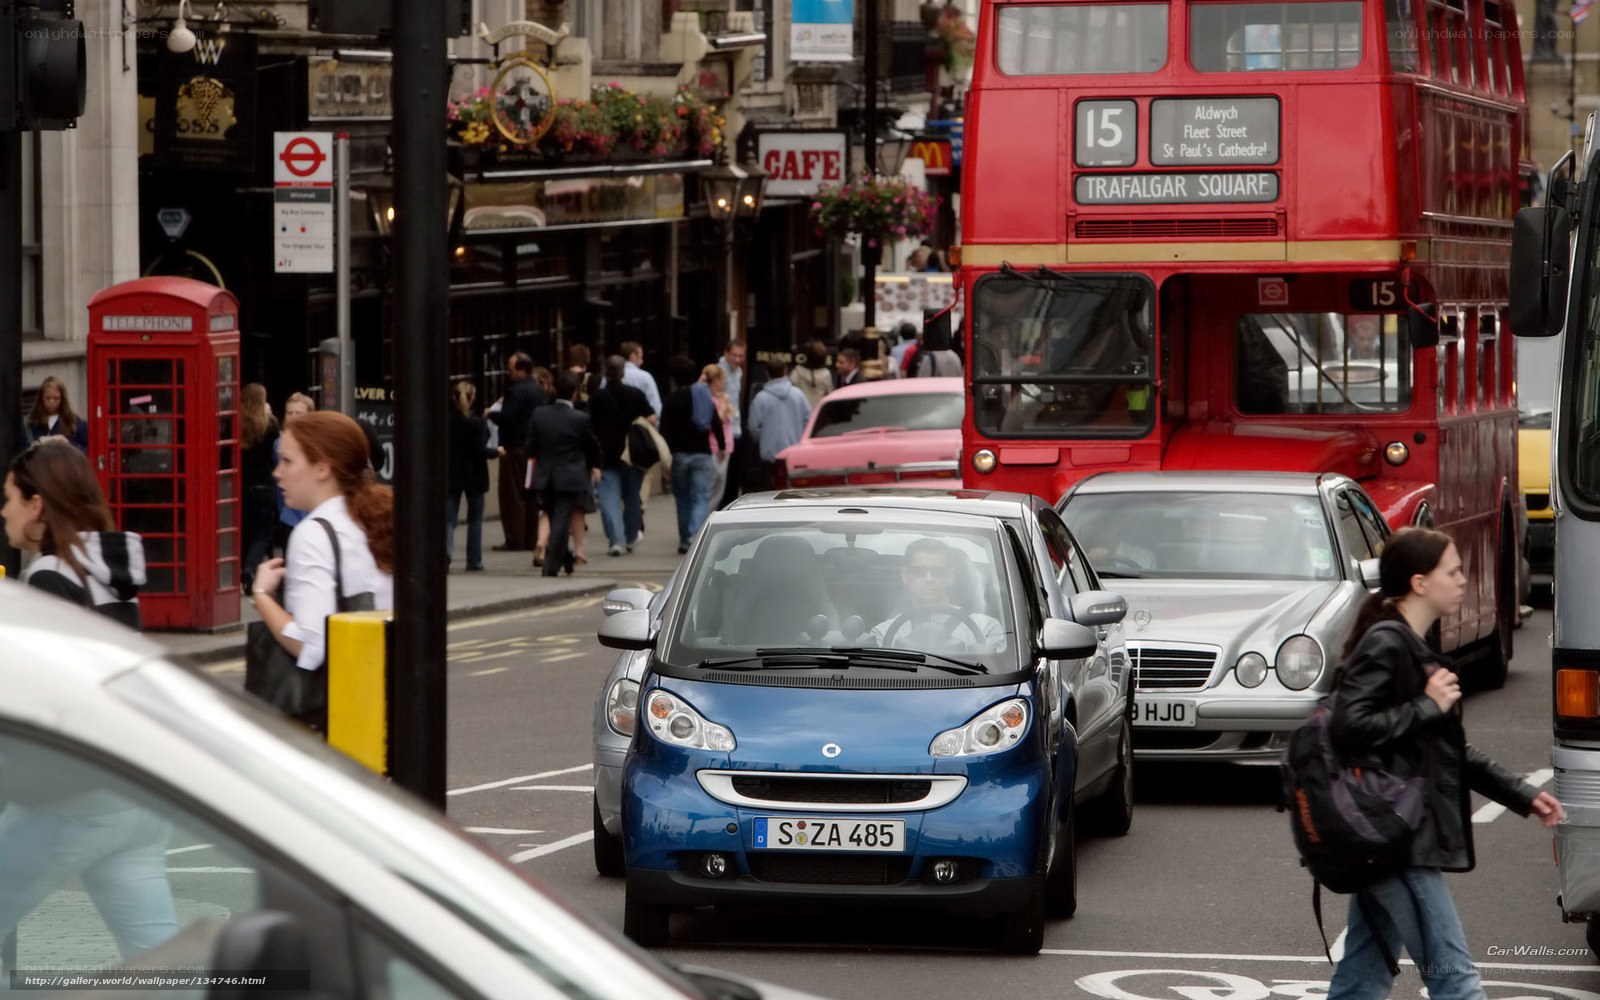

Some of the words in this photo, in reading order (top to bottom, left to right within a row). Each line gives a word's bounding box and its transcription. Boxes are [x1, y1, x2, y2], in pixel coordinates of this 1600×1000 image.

[1195, 105, 1238, 123] Aldwych
[1086, 108, 1123, 148] 15
[1184, 125, 1210, 139] Fleet
[1216, 124, 1247, 138] Street
[1163, 143, 1174, 158] St
[1180, 142, 1213, 157] Paul's
[1218, 142, 1267, 157] Cathedral
[764, 150, 841, 181] CAFE
[1085, 175, 1187, 199] TRAFALGAR
[1198, 174, 1269, 196] SQUARE
[1372, 281, 1396, 306] 15
[108, 316, 190, 330] TELEPHONE
[354, 387, 386, 400] LVER
[1145, 703, 1185, 721] HJO
[758, 835, 764, 844] D
[778, 822, 793, 846] S
[810, 822, 842, 847] ZA
[848, 823, 894, 847] 485
